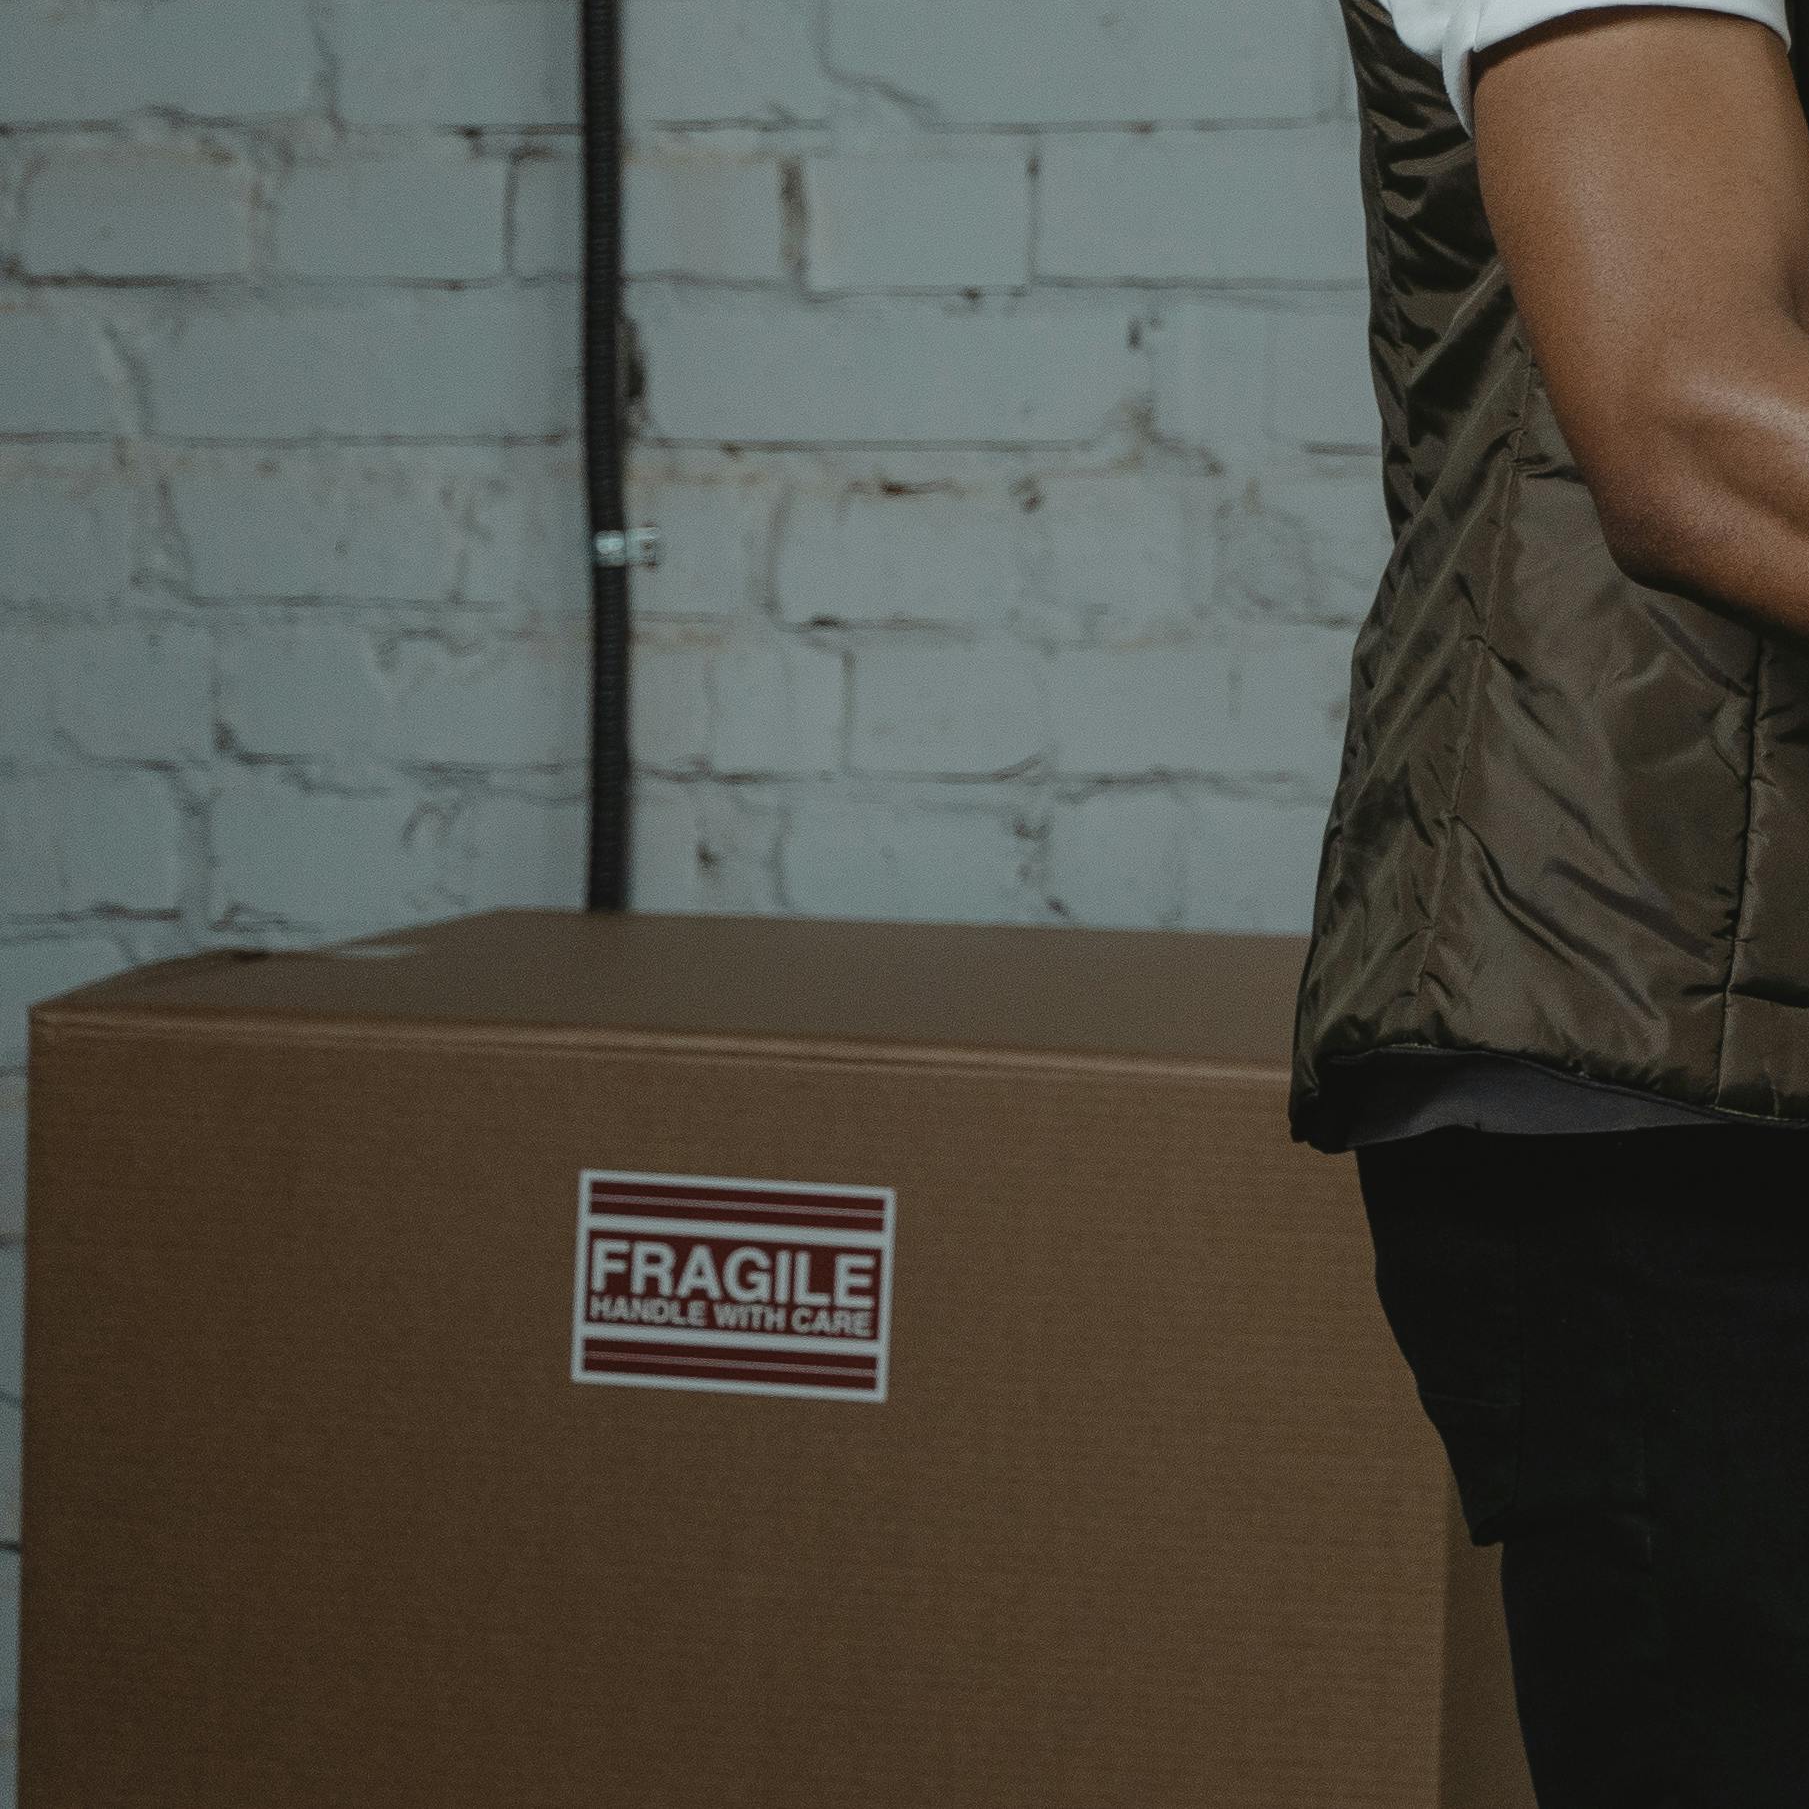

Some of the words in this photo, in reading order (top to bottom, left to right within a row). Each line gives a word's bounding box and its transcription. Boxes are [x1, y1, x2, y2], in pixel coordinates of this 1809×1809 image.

[592, 1238, 876, 1309] FRAGILE
[589, 1295, 706, 1326] HANDLE
[713, 1302, 786, 1331] WITH
[790, 1306, 872, 1337] CARE
